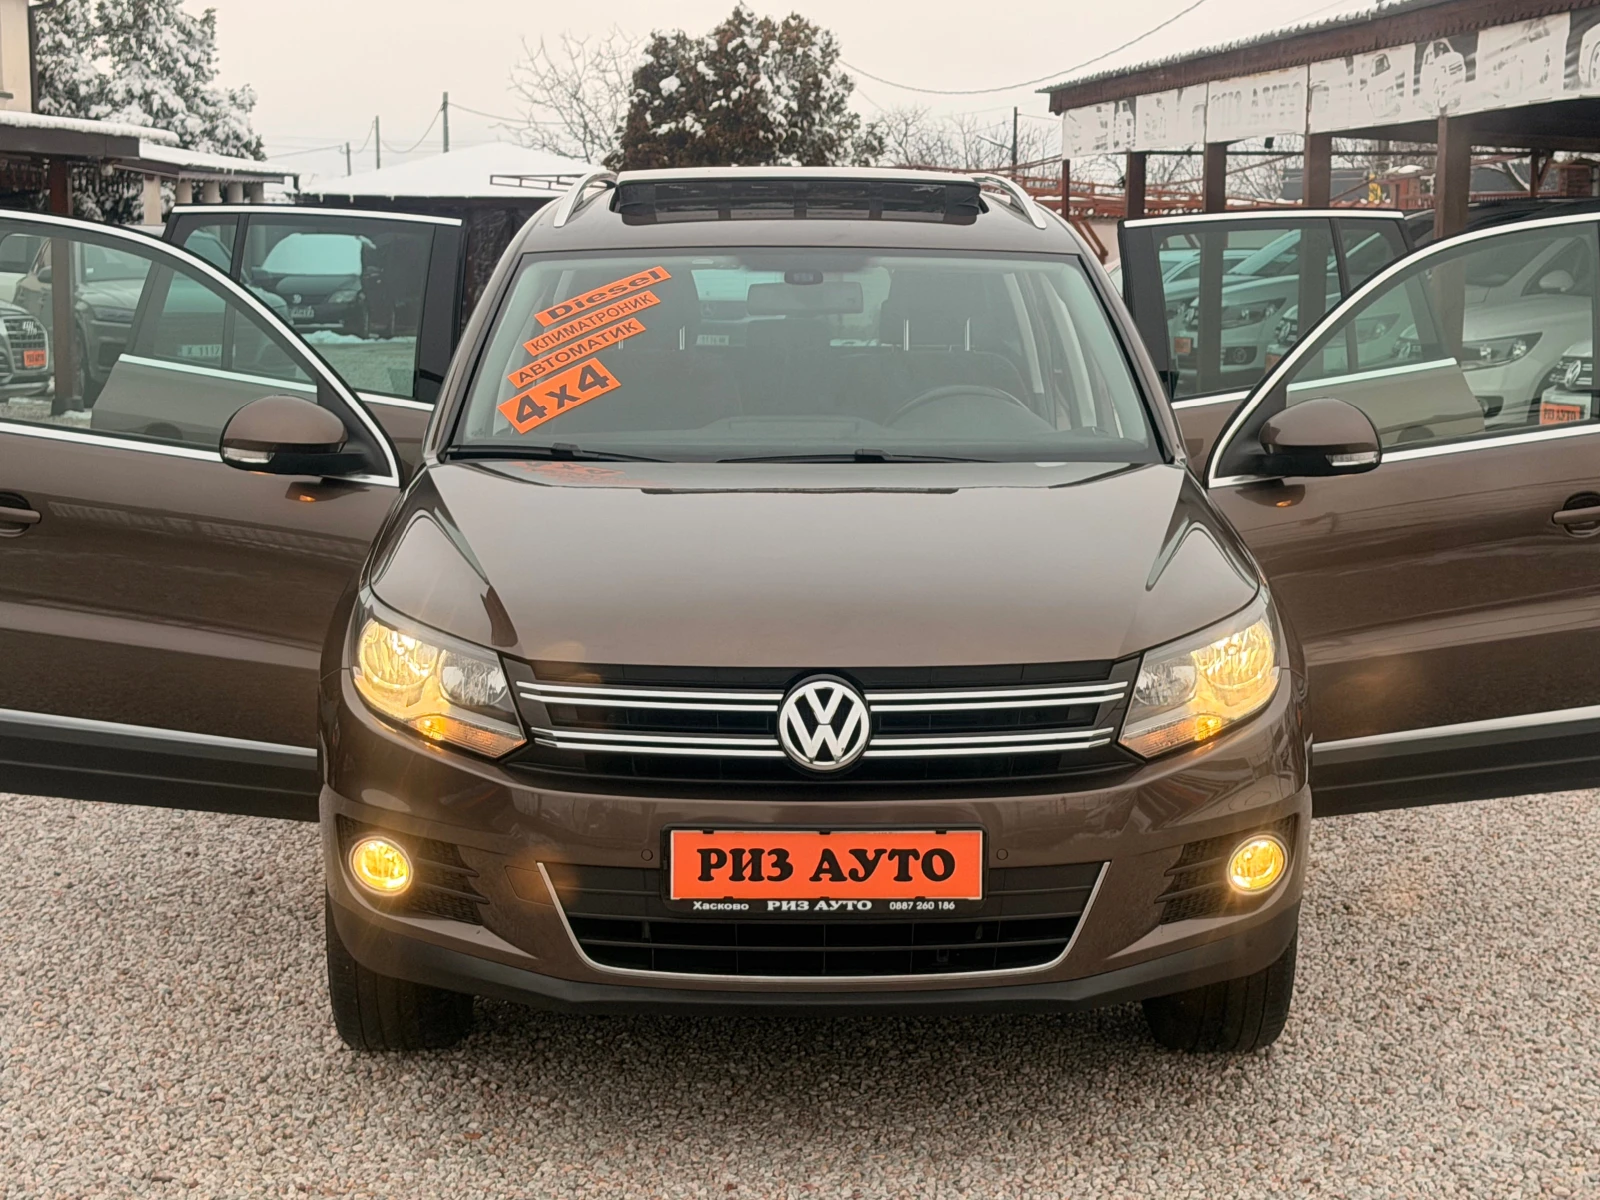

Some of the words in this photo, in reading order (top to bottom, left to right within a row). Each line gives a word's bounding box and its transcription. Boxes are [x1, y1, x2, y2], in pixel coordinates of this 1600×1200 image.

[546, 270, 662, 321] Diesel
[530, 294, 654, 352] КЛИМАТРОНИК
[517, 321, 639, 384] АВТОМАТИК
[696, 847, 794, 883] РИЗ
[808, 847, 956, 883] АУТО
[692, 900, 749, 911] Хасково
[766, 900, 810, 911] РИЗ
[813, 900, 873, 911] АУТО
[889, 901, 914, 911] 0887
[916, 901, 935, 911] 260
[937, 901, 956, 911] 186
